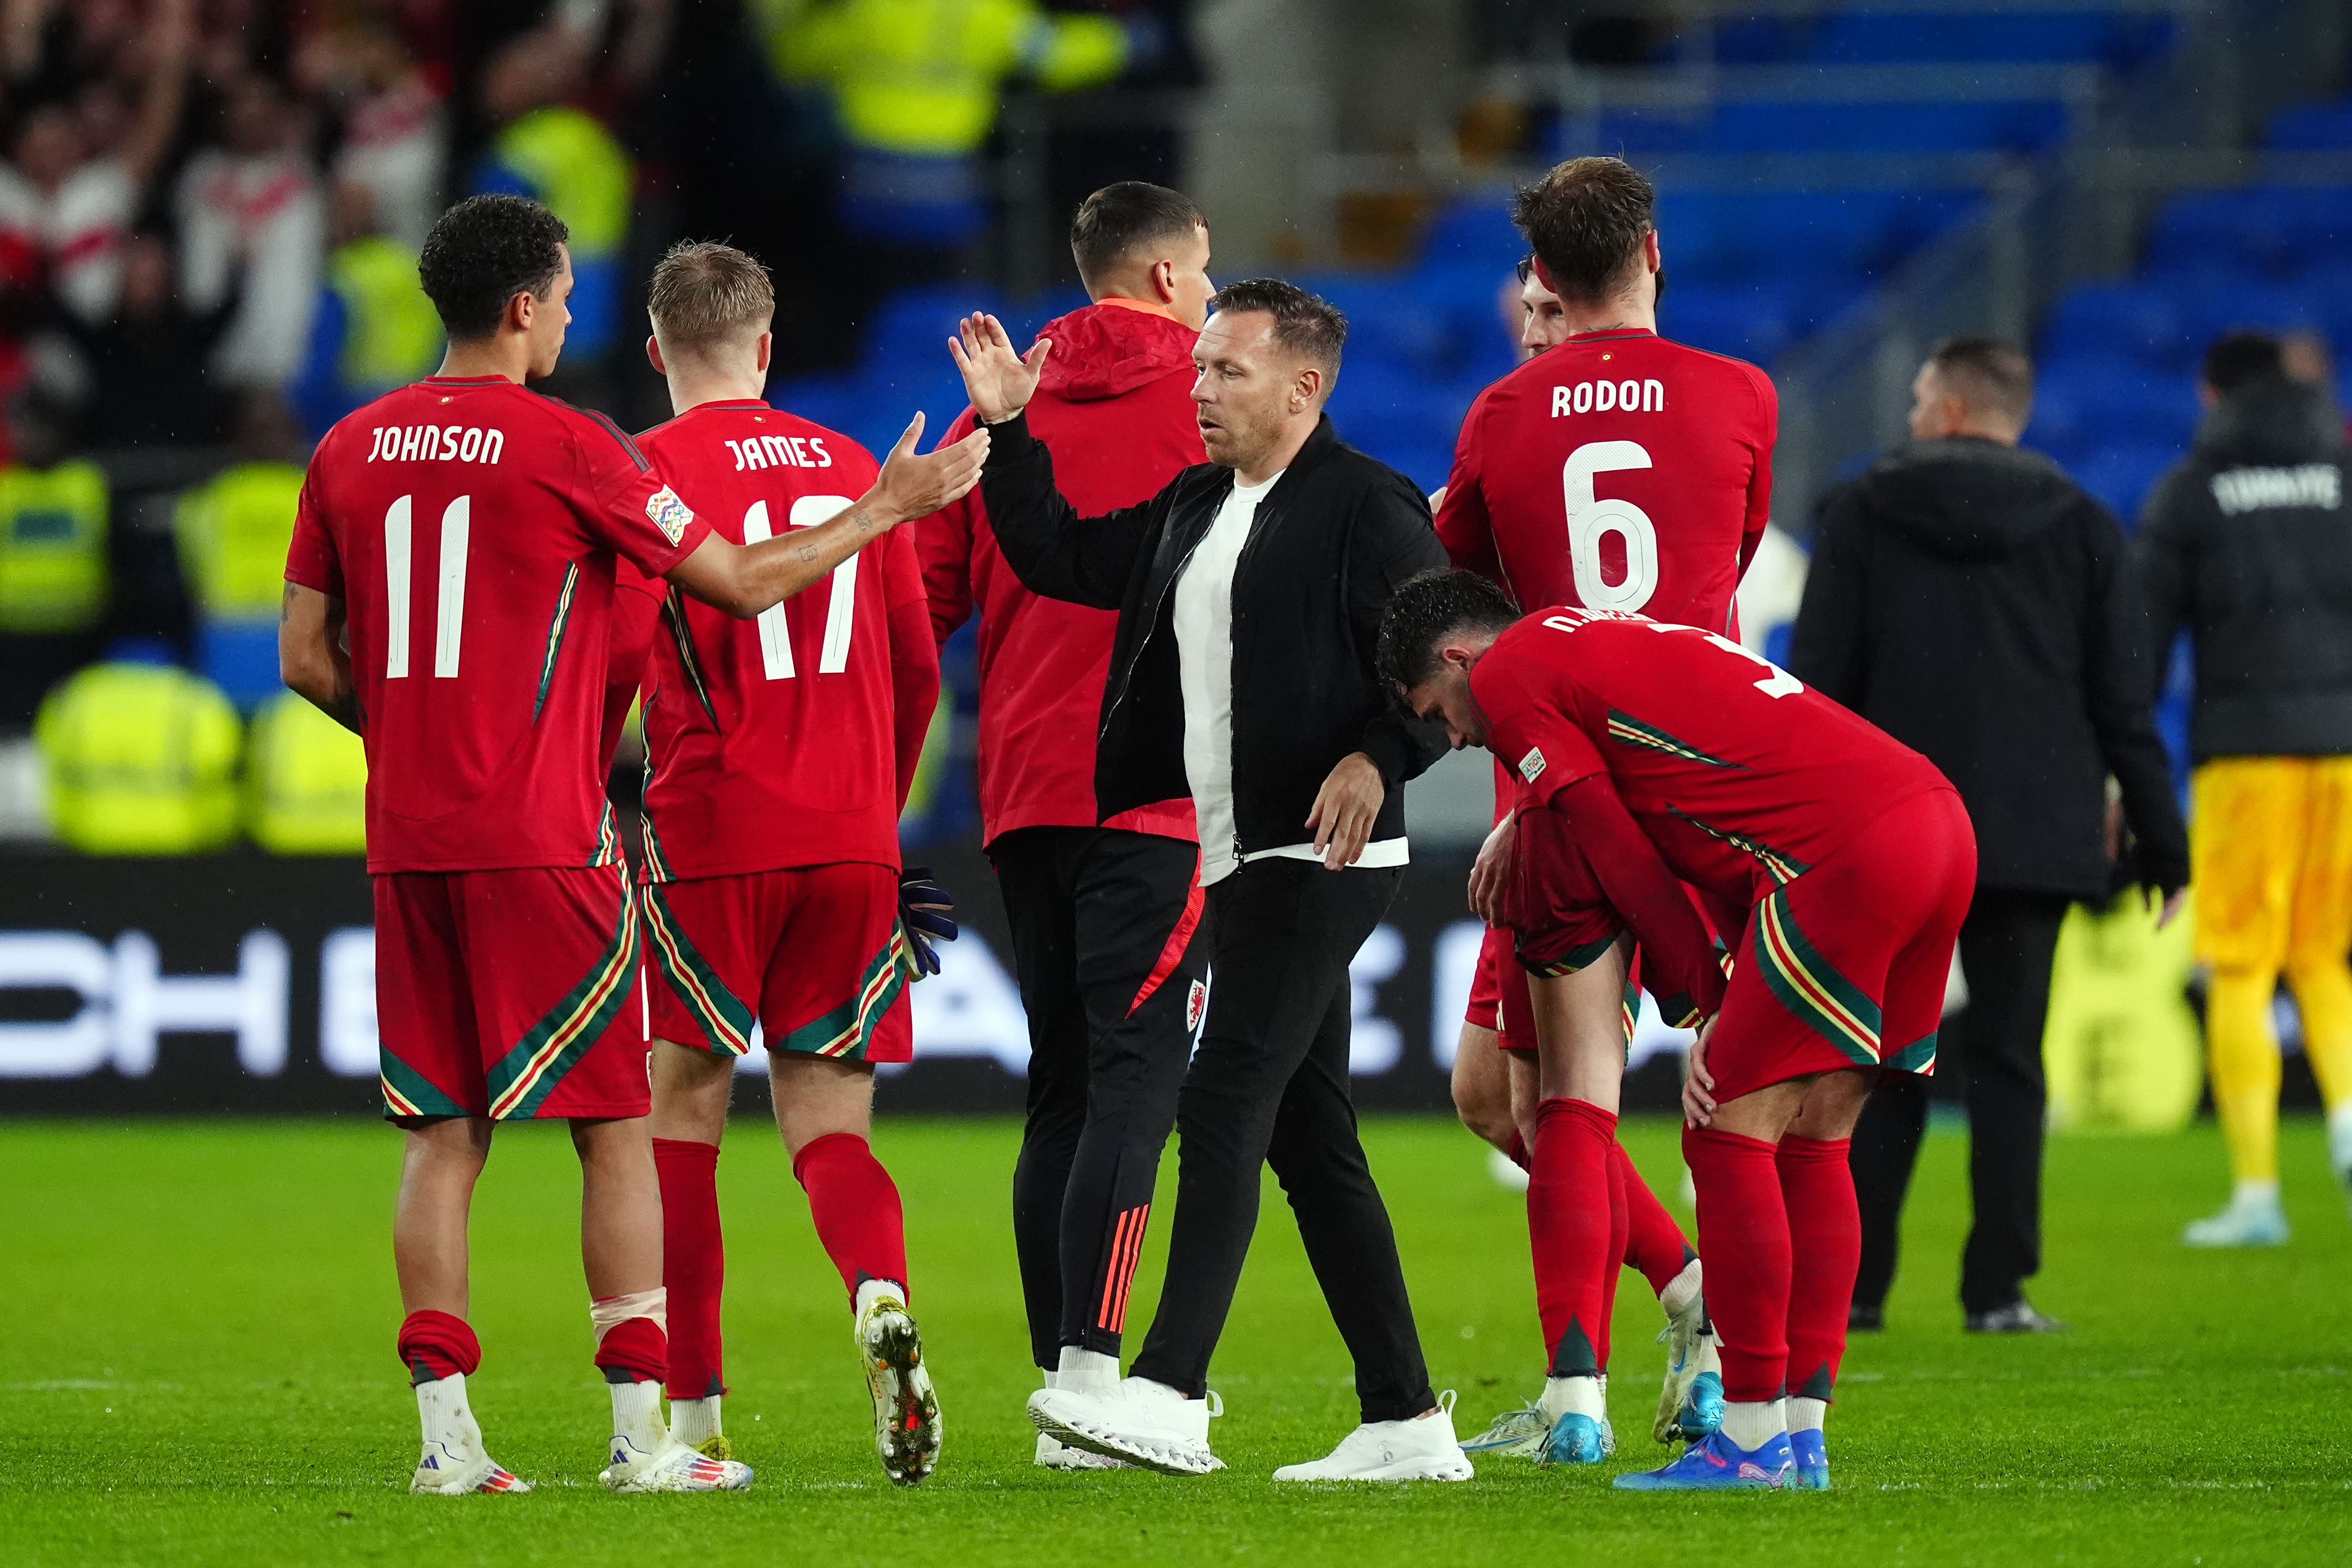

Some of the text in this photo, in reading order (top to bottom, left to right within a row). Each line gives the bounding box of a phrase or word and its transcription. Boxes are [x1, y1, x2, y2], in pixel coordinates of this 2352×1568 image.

[368, 425, 503, 464] JOHNSON
[1552, 380, 1663, 418] RODON
[725, 436, 831, 471] JAMES
[1563, 441, 1658, 611] 6
[385, 495, 470, 678] 11
[744, 496, 859, 680] 17
